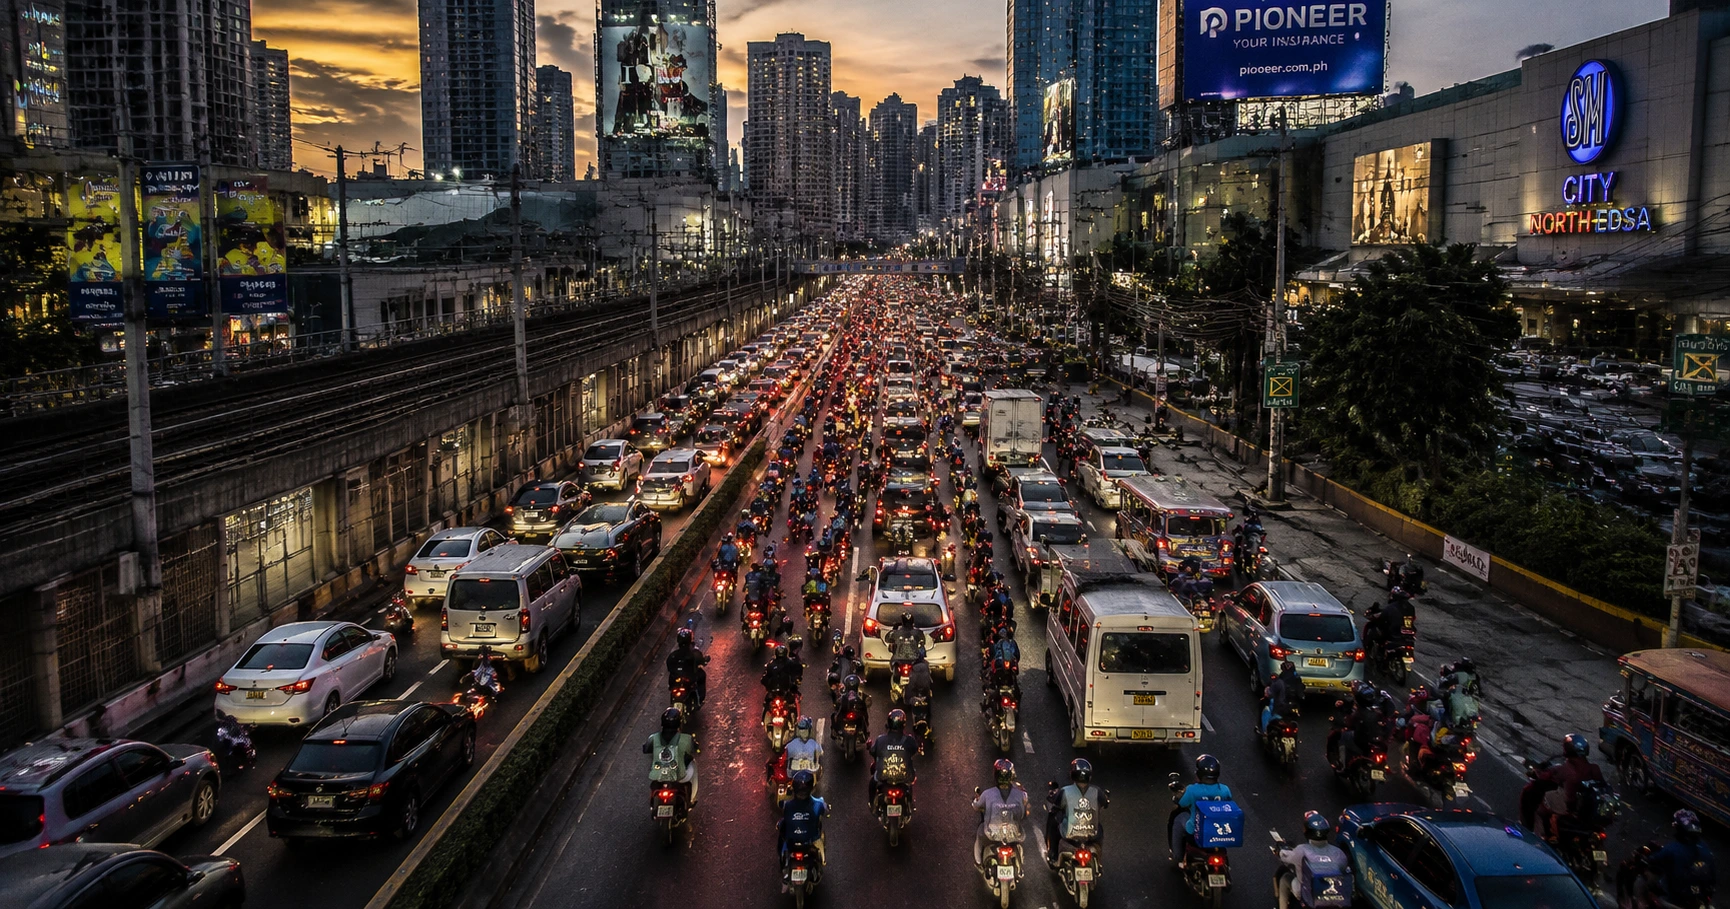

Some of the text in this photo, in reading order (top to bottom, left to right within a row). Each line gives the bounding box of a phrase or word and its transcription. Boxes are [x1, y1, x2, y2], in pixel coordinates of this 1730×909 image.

[1235, 3, 1367, 32] PIONEER
[1233, 37, 1268, 49] YOUR
[1566, 70, 1607, 148] SM
[1563, 171, 1615, 204] CITY
[1529, 206, 1651, 235] NORTH EDSA
